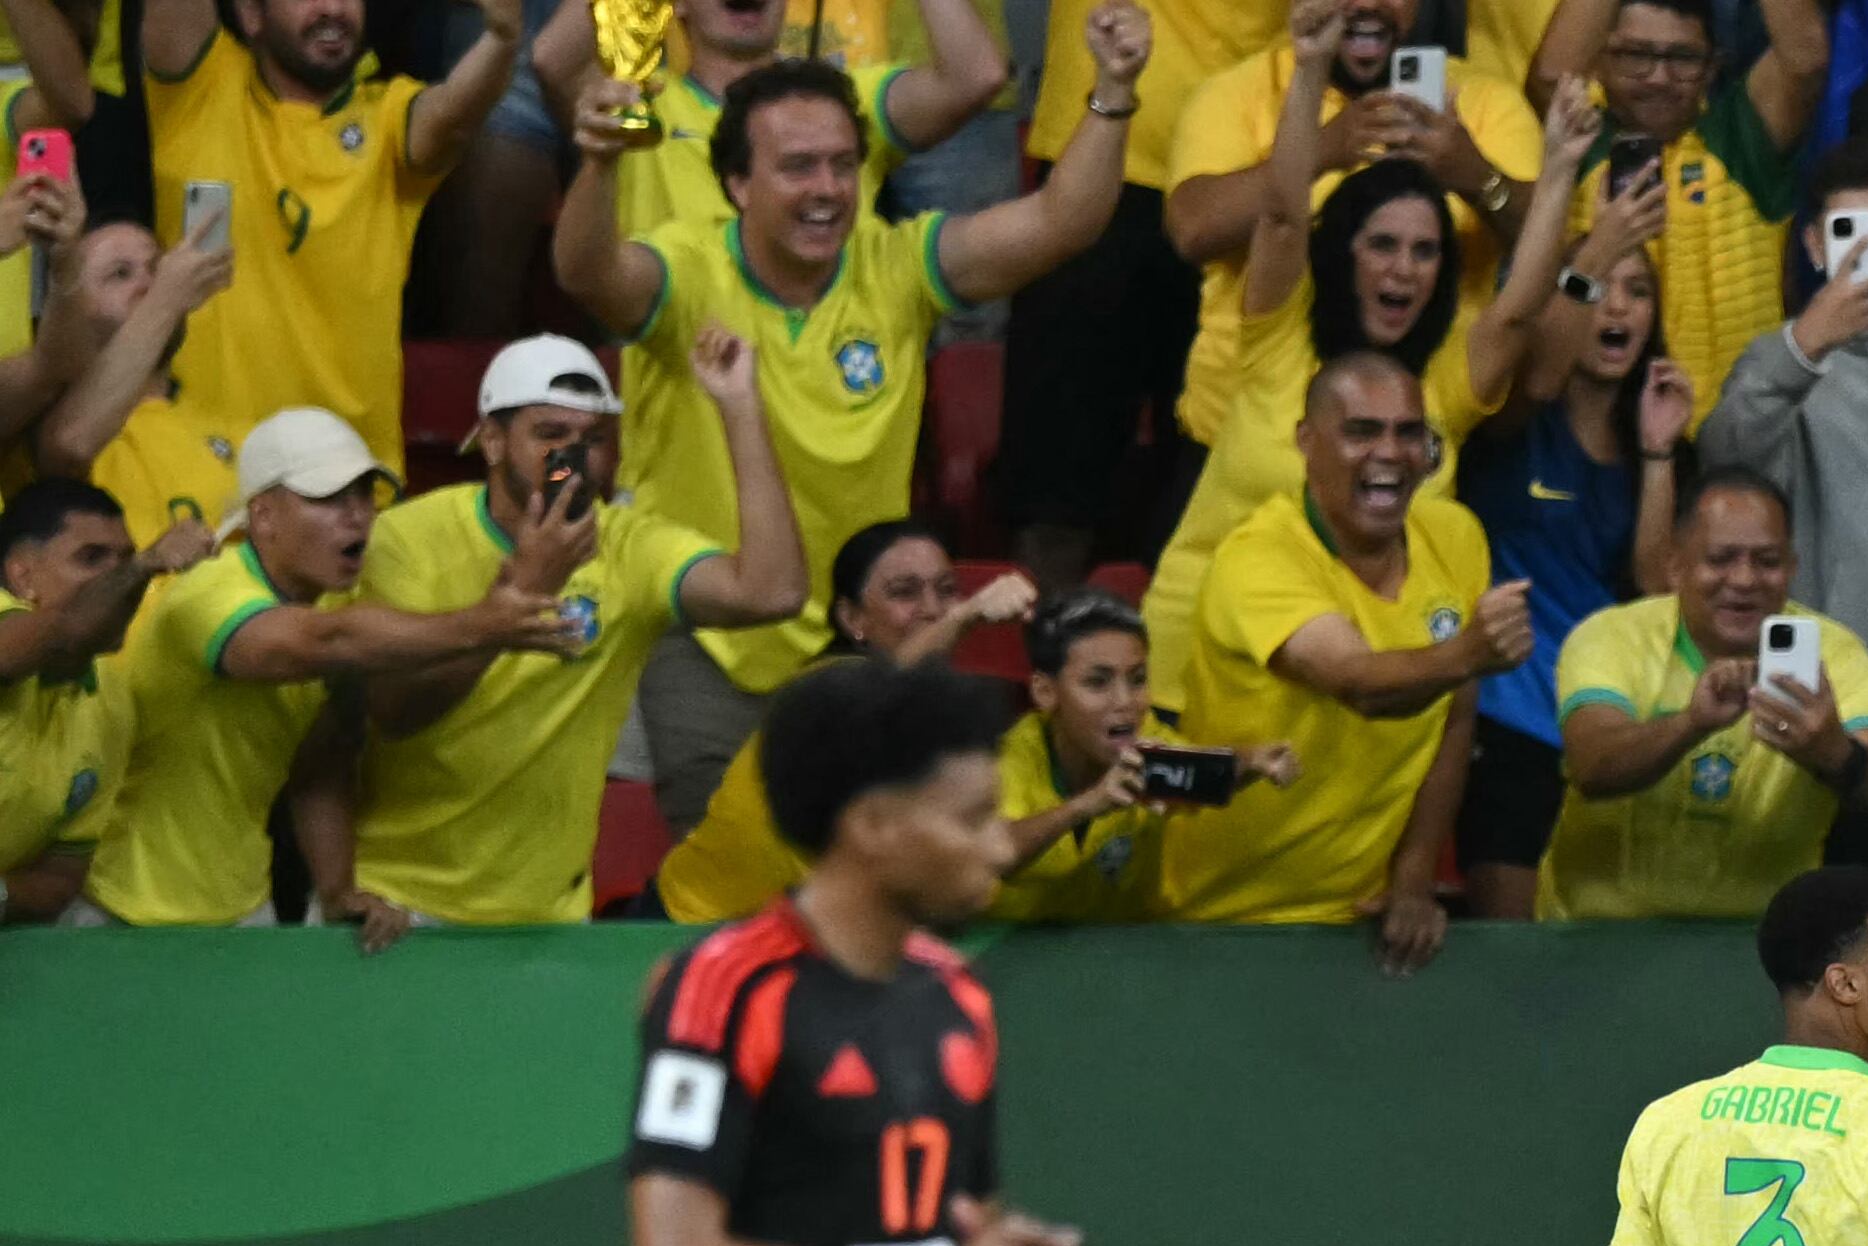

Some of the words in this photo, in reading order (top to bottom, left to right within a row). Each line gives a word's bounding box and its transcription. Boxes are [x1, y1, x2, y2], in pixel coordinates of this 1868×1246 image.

[277, 187, 311, 255] 9
[1700, 1085, 1847, 1136] GABRIEL
[881, 1117, 950, 1233] 17
